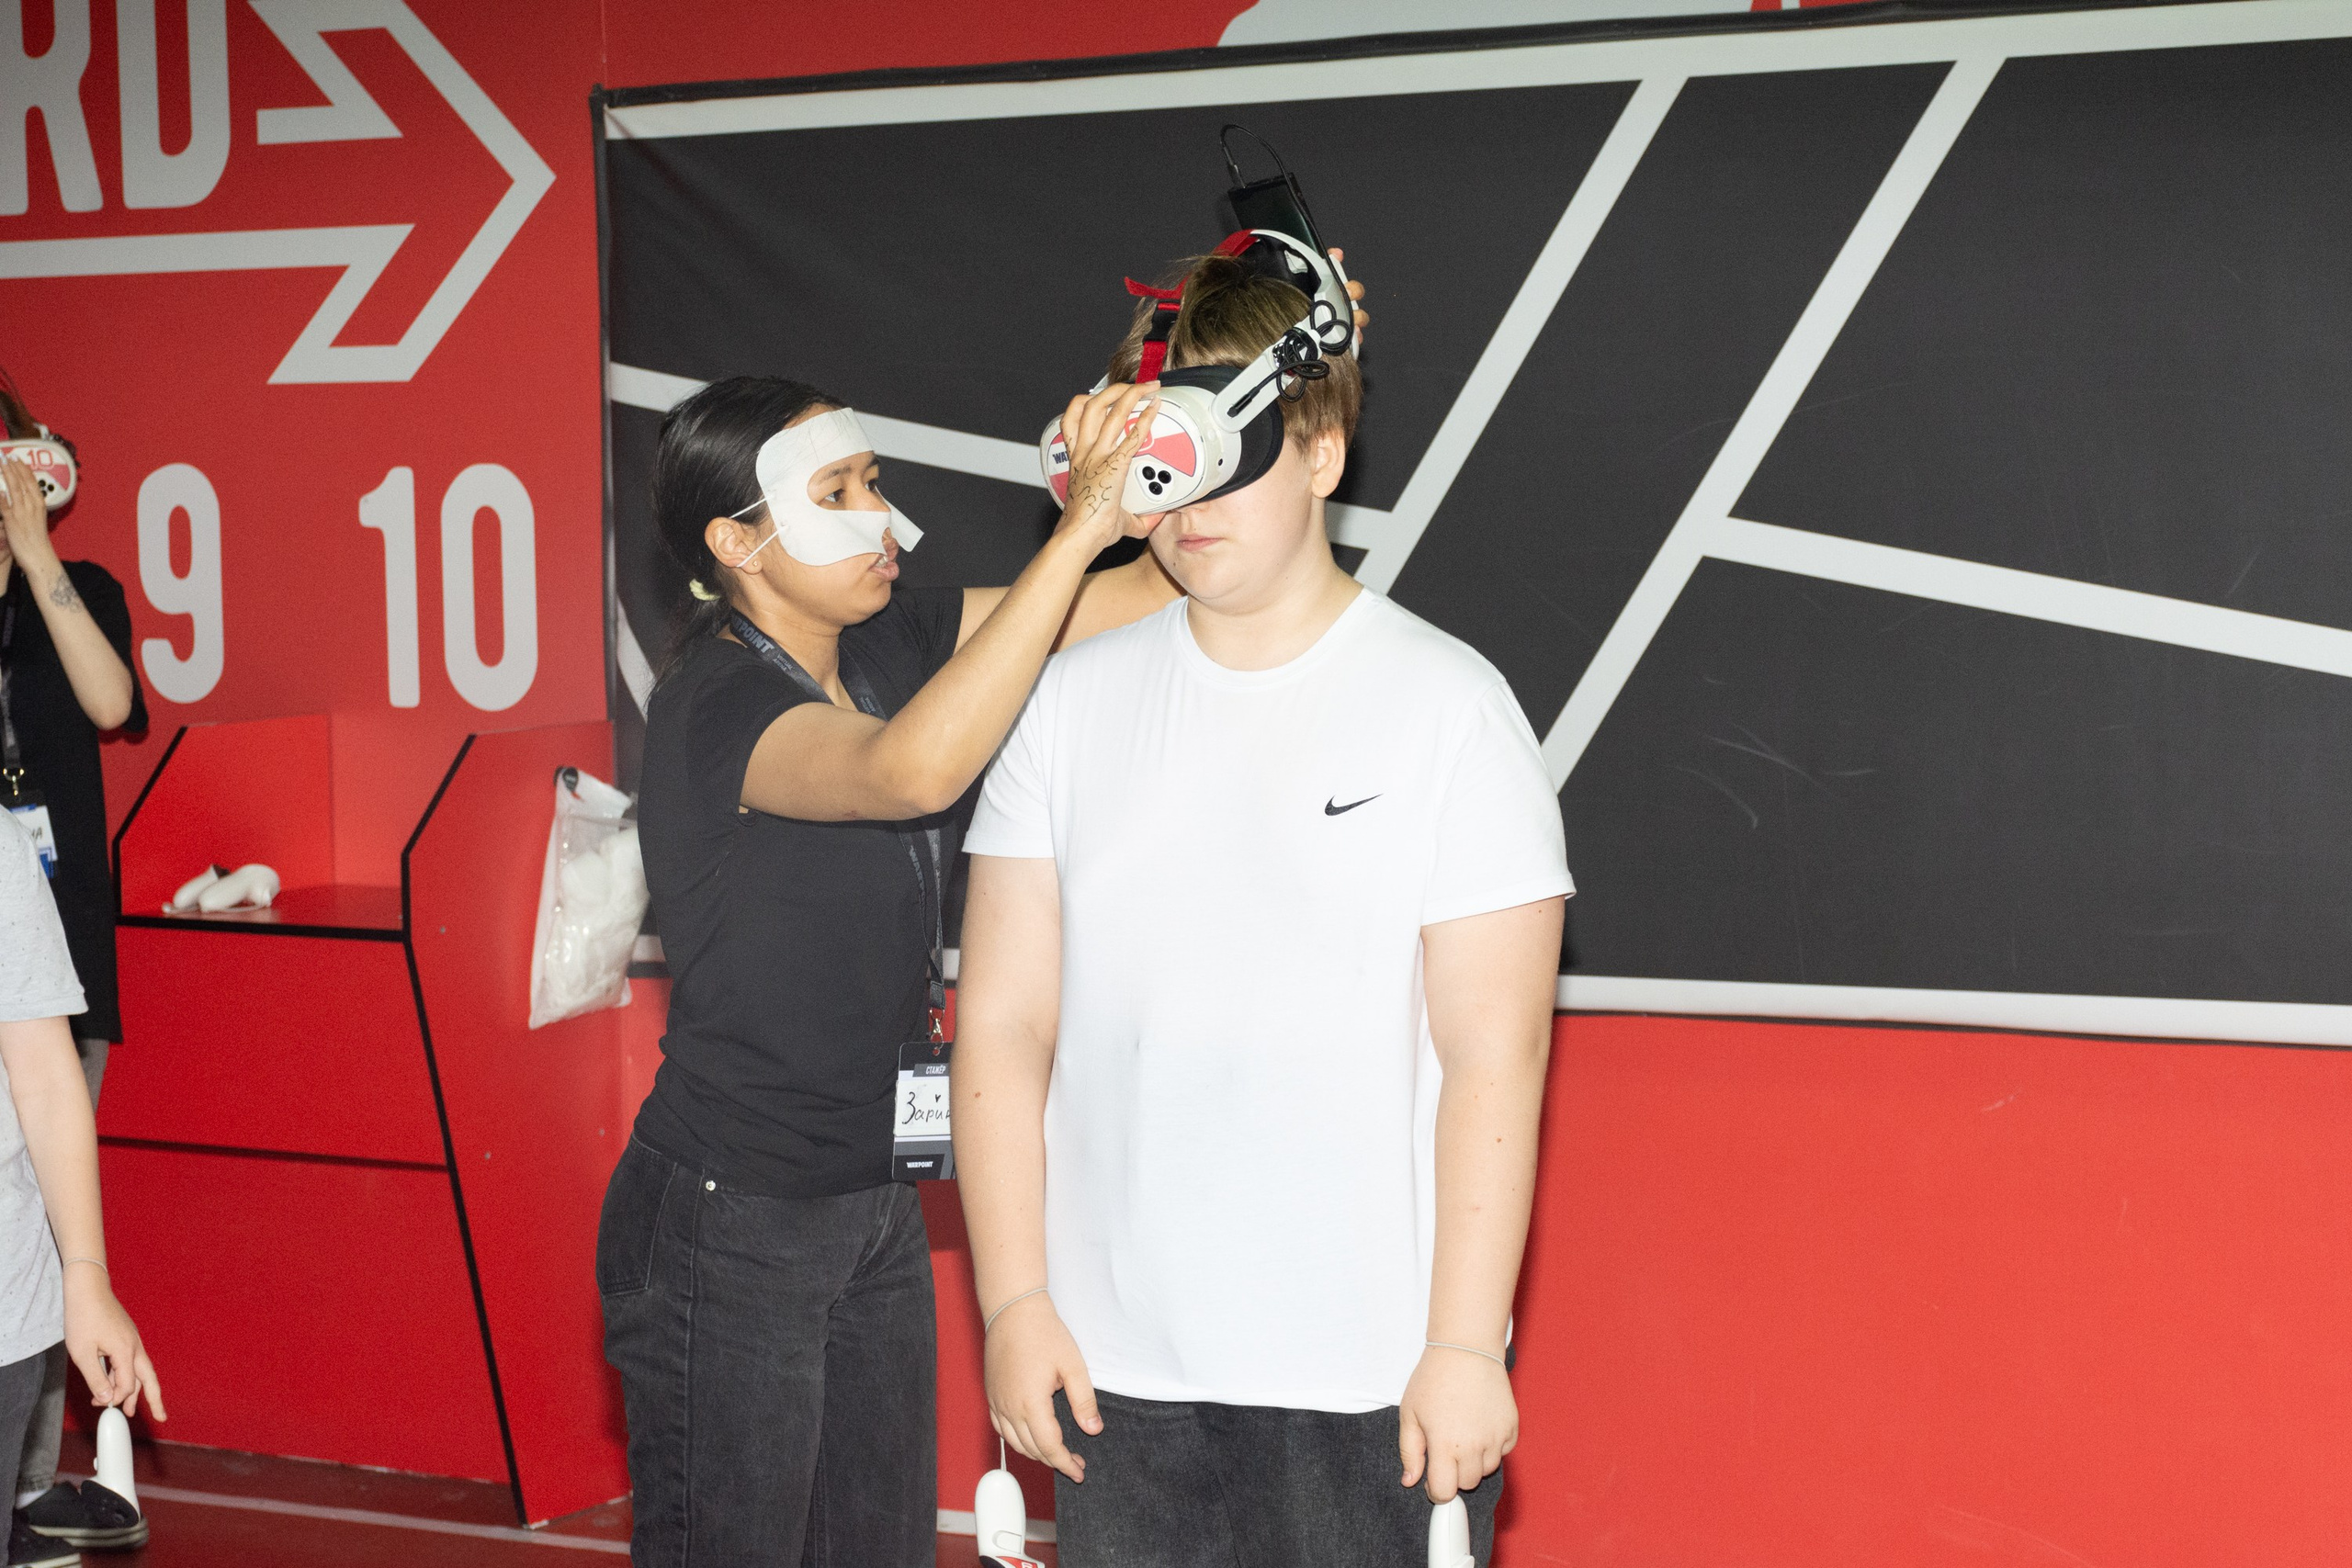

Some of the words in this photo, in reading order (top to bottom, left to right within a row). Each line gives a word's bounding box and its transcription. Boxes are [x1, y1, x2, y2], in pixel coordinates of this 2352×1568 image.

[27, 449, 53, 467] 10
[137, 462, 224, 704] 9
[358, 463, 538, 712] 10
[906, 1160, 933, 1168] WARPOINT
